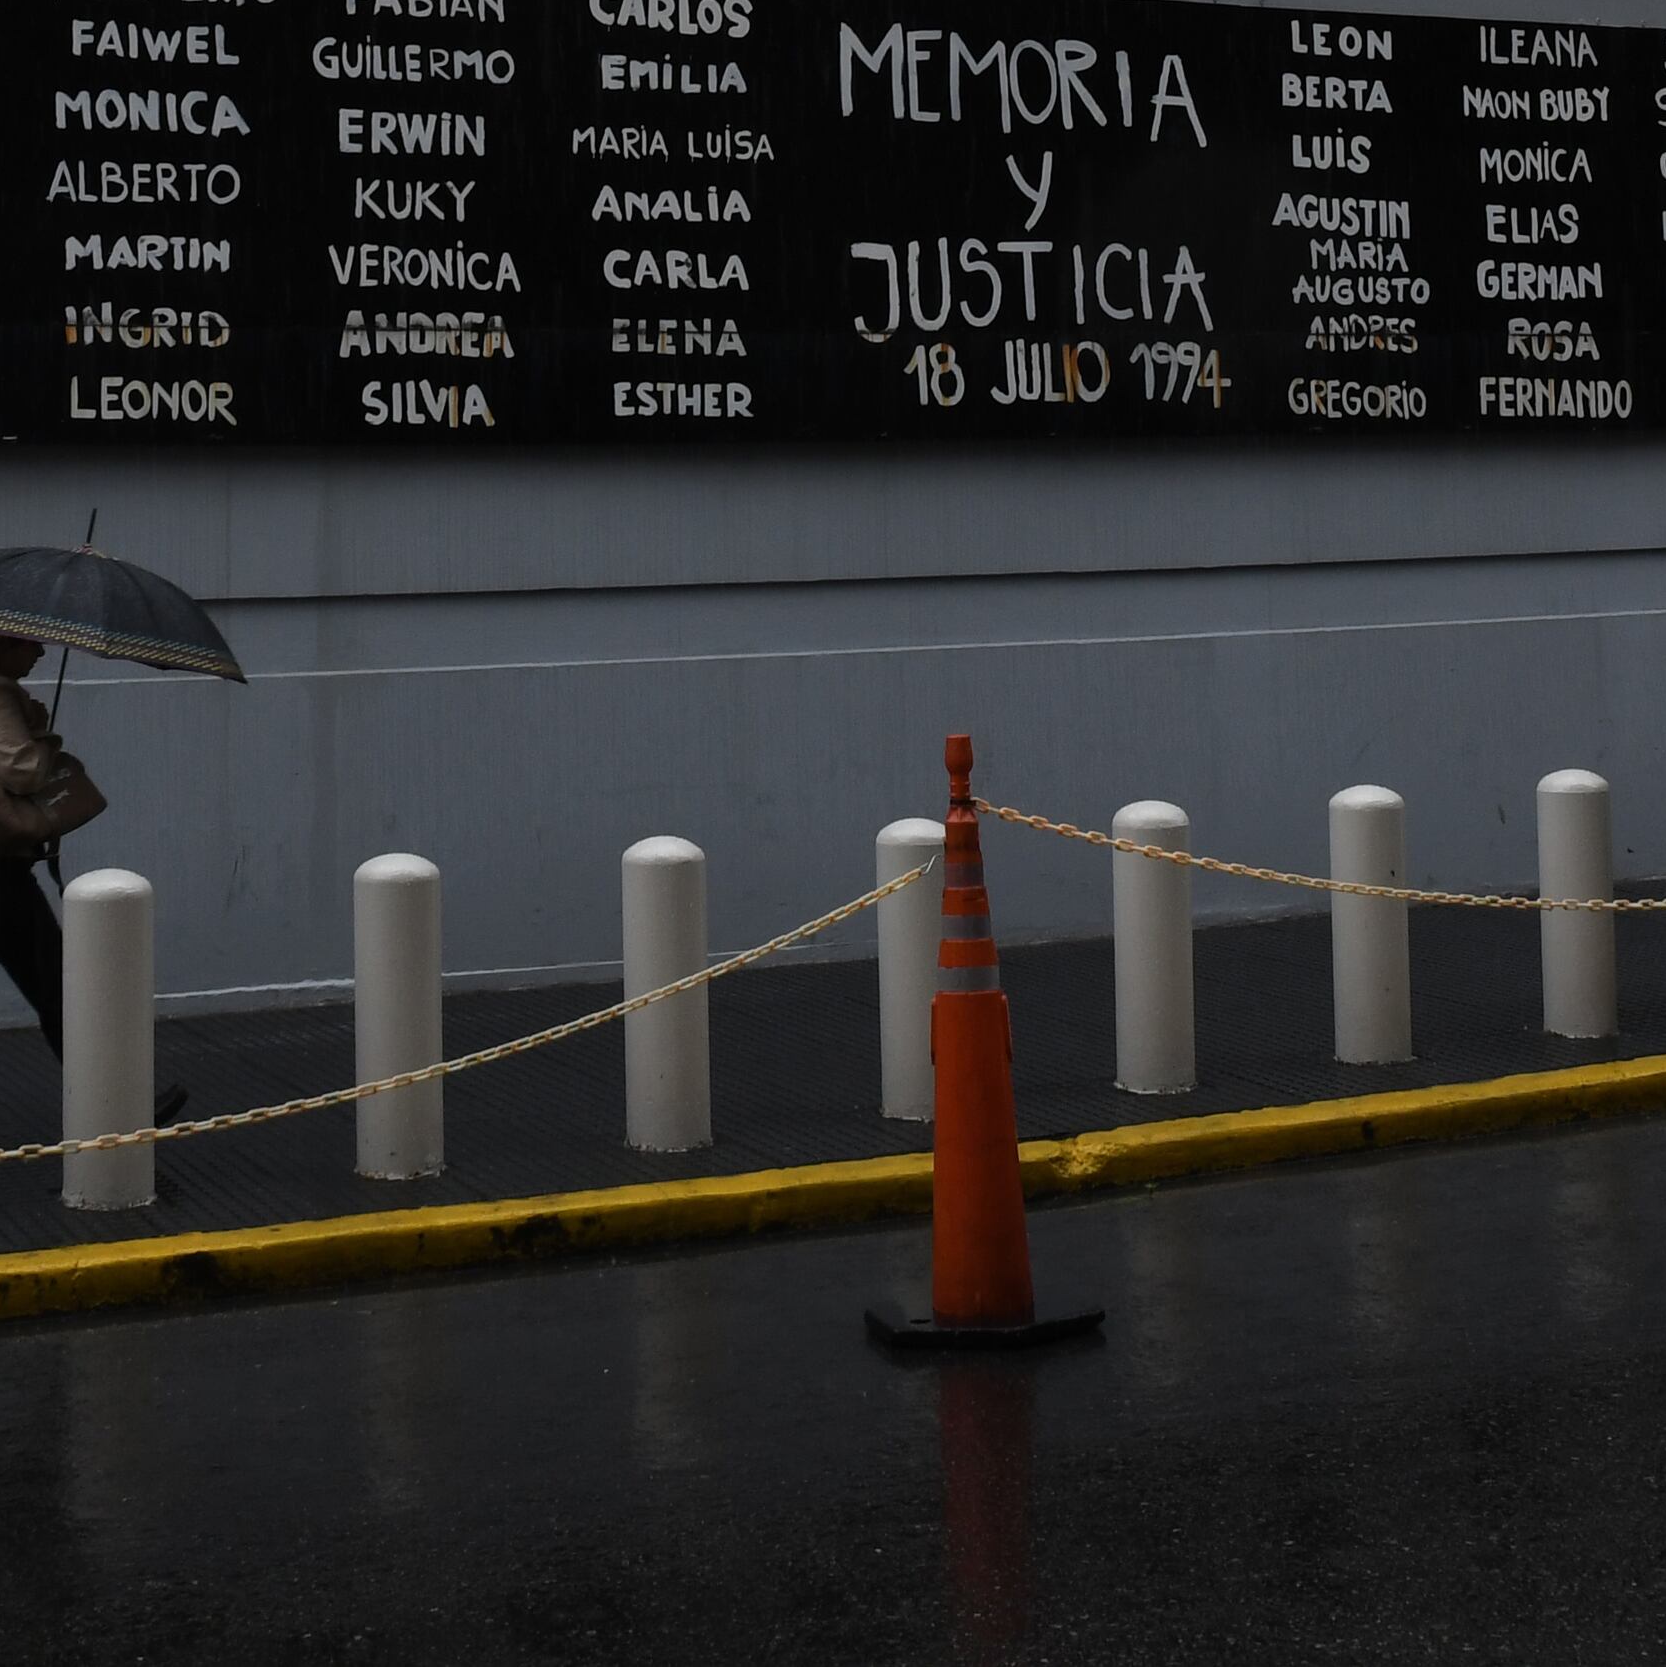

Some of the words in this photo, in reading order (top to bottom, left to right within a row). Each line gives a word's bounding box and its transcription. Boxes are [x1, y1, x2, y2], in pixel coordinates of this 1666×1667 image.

[71, 19, 240, 65] FAIWEL
[312, 36, 515, 84] GUILLERMO
[1290, 19, 1392, 60] LEON
[1479, 25, 1598, 68] ILEANA
[598, 53, 747, 94] EMILIA
[839, 21, 1208, 148] MEMORIA
[1282, 73, 1393, 113] BERTA
[54, 89, 251, 137] MONICA
[1463, 85, 1531, 121] NAON
[1540, 86, 1610, 122] BUBY
[338, 108, 486, 156] ERWIN
[572, 125, 668, 162] MARIA
[687, 124, 775, 164] LUISA
[1292, 128, 1372, 174] LUIS
[46, 161, 241, 205] ALBERTO
[1479, 141, 1593, 185] MONICA
[353, 177, 476, 222] KUKY
[591, 184, 752, 223] ANALIA
[1272, 193, 1410, 239] AGUSTIN
[1485, 204, 1580, 244] ELIAS
[64, 234, 231, 273] MARTIN
[328, 240, 521, 292] VERONICA
[602, 249, 749, 291] CARLA
[1310, 238, 1410, 272] MARIA
[850, 236, 1215, 343] JUSTICIA
[1292, 275, 1431, 305] AUGUSTO
[1476, 260, 1603, 302] GERMAN
[65, 301, 230, 348] INGRID
[339, 309, 515, 358] ANDREA
[612, 317, 747, 357] ELENA
[1305, 314, 1418, 353] ANDRES
[1507, 317, 1600, 361] ROSA
[904, 342, 965, 406] 18
[990, 338, 1111, 404] JULIO
[1129, 340, 1232, 409] 1994
[69, 375, 237, 425] LEONOR
[361, 378, 495, 428] SILVIA
[613, 381, 754, 418] ESTHER
[1288, 377, 1427, 420] GREGORIO
[1479, 376, 1633, 419] FERNANDO
